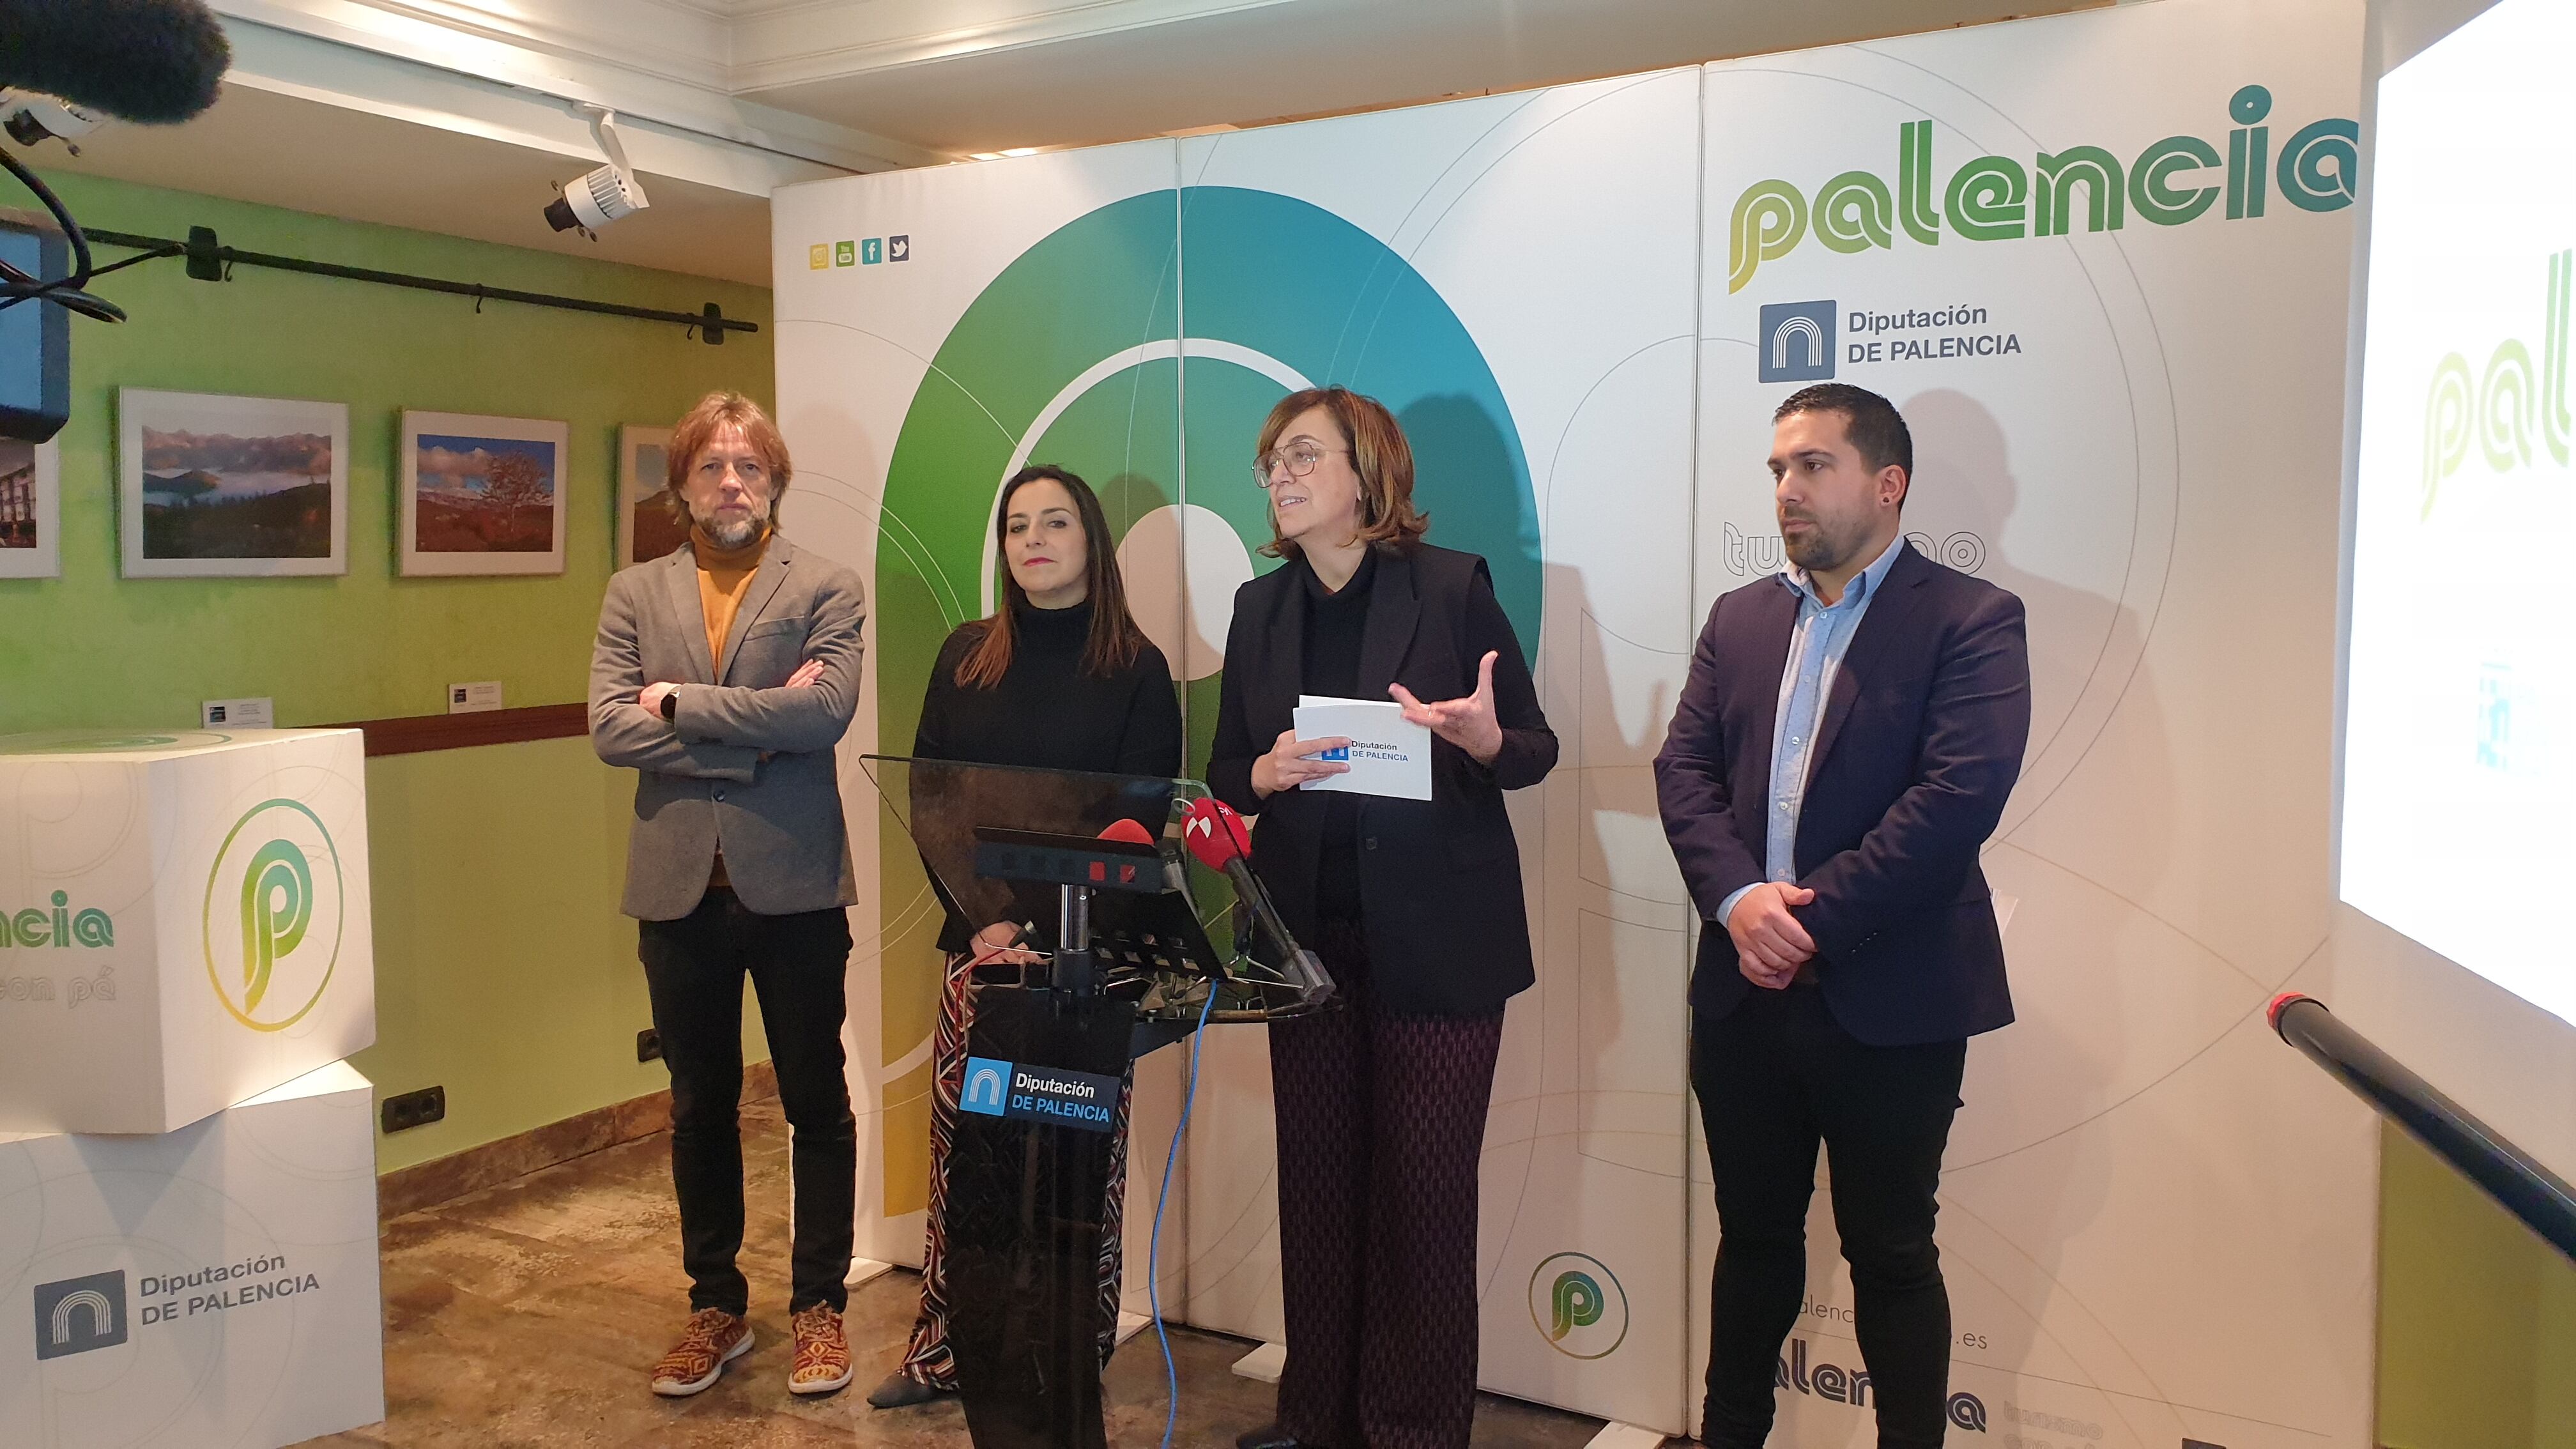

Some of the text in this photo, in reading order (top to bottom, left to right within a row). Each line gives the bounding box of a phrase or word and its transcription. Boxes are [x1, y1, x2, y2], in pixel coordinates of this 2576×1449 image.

[1728, 84, 2360, 295] palencia
[1850, 303, 1988, 335] Diputación
[1848, 334, 2022, 364] DE PALENCIA
[1351, 740, 1397, 751] Diputación
[1366, 751, 1409, 762] PALENCIA
[1015, 1073, 1095, 1098] Diputación
[1012, 1094, 1110, 1123] DE PALENCIA
[140, 1254, 286, 1297] Diputación
[142, 1273, 320, 1326] DE PALENCIA
